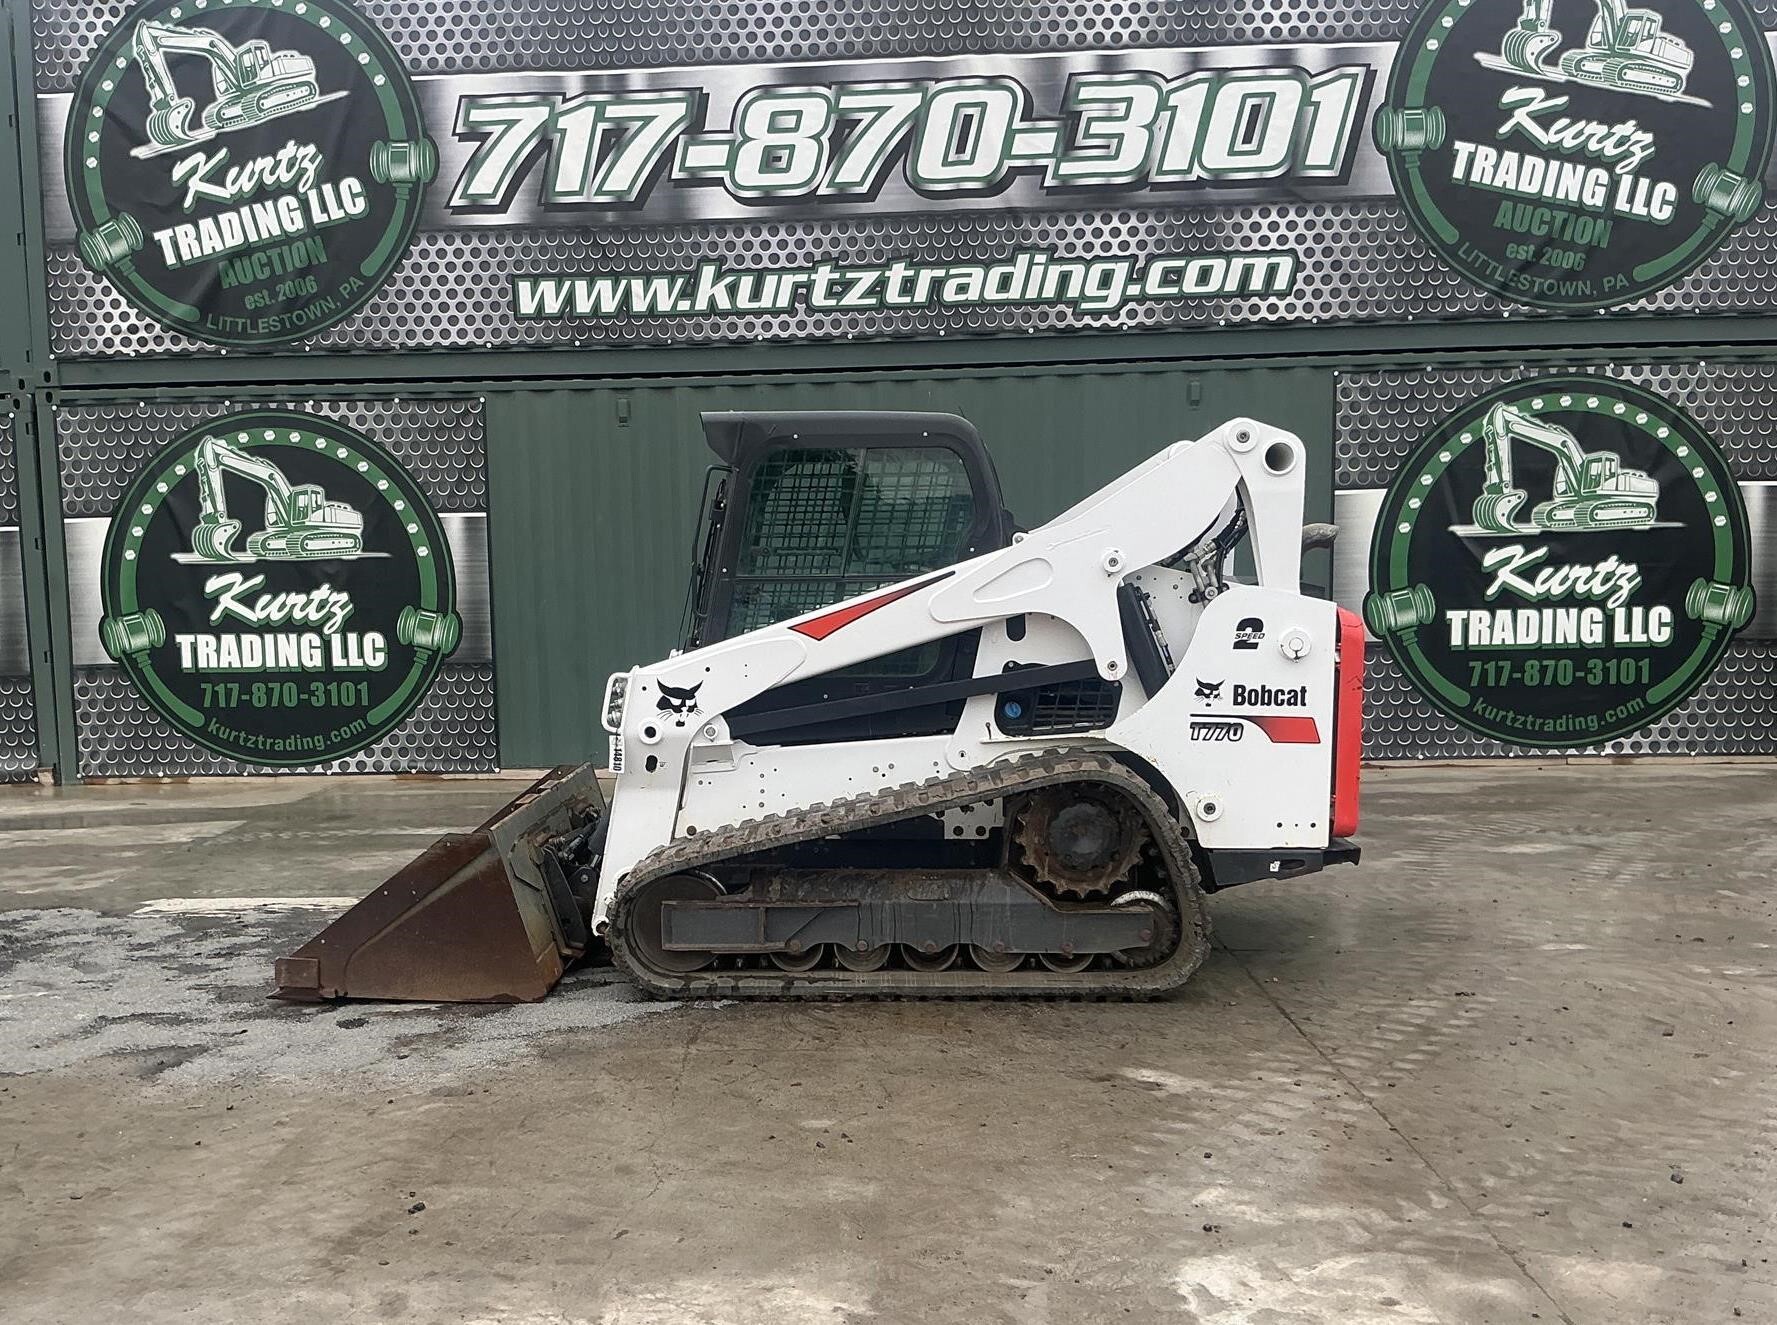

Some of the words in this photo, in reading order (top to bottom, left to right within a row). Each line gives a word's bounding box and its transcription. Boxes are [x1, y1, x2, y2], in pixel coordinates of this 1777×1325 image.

[452, 68, 1366, 212] 717-870-3101
[1498, 86, 1656, 174] Kurtz
[172, 140, 323, 212] Kurtz
[1451, 140, 1611, 209] TRADING
[1614, 174, 1678, 225] LLC
[153, 193, 305, 270] TRADING
[306, 176, 368, 226] LLC
[1493, 201, 1613, 248] AUCTION
[218, 236, 328, 288] AUCTION
[1457, 241, 1597, 297] LITTLESTOWN,
[1603, 275, 1630, 292] PA
[1505, 242, 1536, 262] est.
[1539, 246, 1586, 272] 2006
[244, 288, 276, 310] est.
[276, 275, 318, 302] 2006
[514, 249, 1297, 314] www.kurtztrading.com
[206, 295, 341, 335] LITTLESTOWN,
[339, 275, 365, 300] PA
[1482, 544, 1643, 608] Kurtz
[204, 572, 354, 634] Kurtz
[1233, 617, 1264, 649] 2
[1234, 632, 1265, 640] SPEED
[1446, 608, 1604, 648] TRADING
[1614, 606, 1675, 648] LLC
[175, 633, 323, 673] TRADING
[330, 631, 389, 673] LLC
[1468, 658, 1651, 688] 717-870-3101
[201, 681, 370, 708] 717-870-3101
[1232, 685, 1307, 707] Bobcat
[1472, 695, 1646, 733] kurtztrading.com
[207, 718, 367, 753] kurtztrading.com
[1190, 722, 1244, 742] T770
